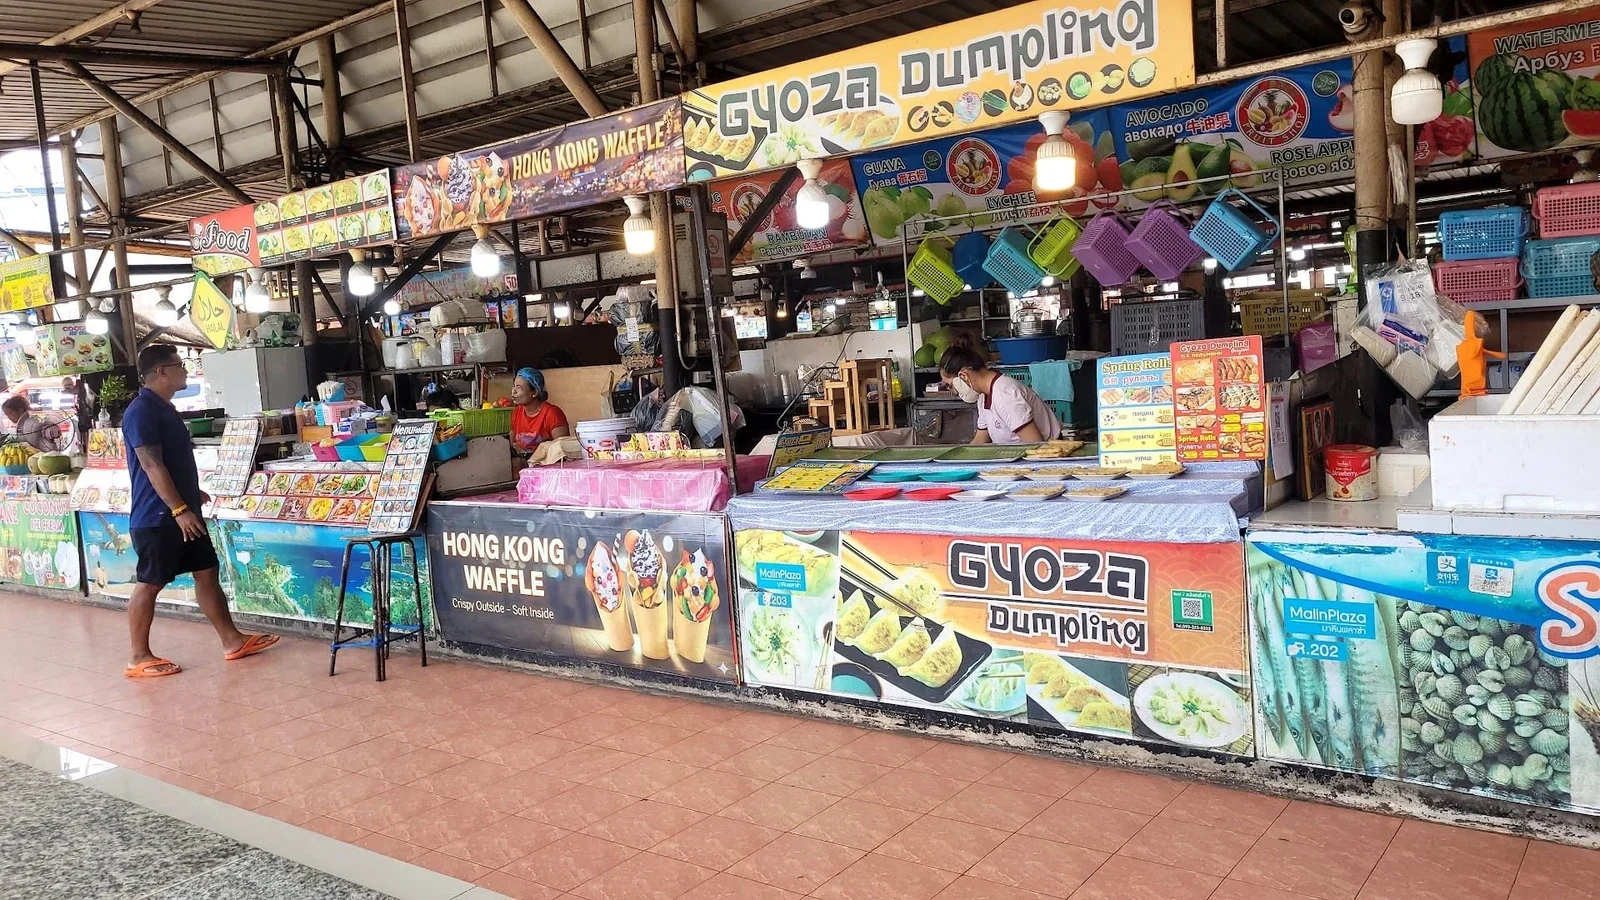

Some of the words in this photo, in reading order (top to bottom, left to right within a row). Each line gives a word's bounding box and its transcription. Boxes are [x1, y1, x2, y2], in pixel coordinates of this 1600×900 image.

[719, 66, 878, 137] Gyoza
[901, 0, 1155, 95] Dumpling
[1513, 49, 1585, 75] Арбуз
[1126, 98, 1209, 128] AVOCADO
[1124, 123, 1183, 143] авокадо
[1185, 111, 1232, 135] 牛油果
[512, 150, 552, 181] HONG
[555, 137, 600, 171] KONG
[602, 121, 665, 160] WAFFLE
[1271, 145, 1315, 166] ROSE
[863, 157, 907, 177] GUAVA
[868, 177, 898, 191] Гуава
[985, 190, 1037, 211] LYCHEE
[766, 228, 828, 245] RAMBUTAN
[759, 244, 802, 257] Рамбутан
[206, 321, 226, 333] HALAL
[1181, 344, 1208, 353] Gyoza
[1210, 339, 1250, 351] Dumpling
[1102, 360, 1141, 374] Spring
[1143, 357, 1172, 370] Rolls
[1178, 435, 1199, 443] Spring
[1200, 433, 1217, 441] Rolls
[442, 531, 500, 560] HONG
[503, 535, 565, 565] KONG
[463, 564, 545, 597] WAFFLE
[759, 568, 802, 580] MalinPlaza
[949, 541, 1146, 602] Gyoza
[452, 598, 474, 612] Crispy
[475, 600, 505, 614] Outside
[512, 604, 529, 617] Soft
[530, 606, 555, 620] Inside
[1289, 606, 1367, 624] MalinPlaza
[989, 605, 1146, 653] Dumpling
